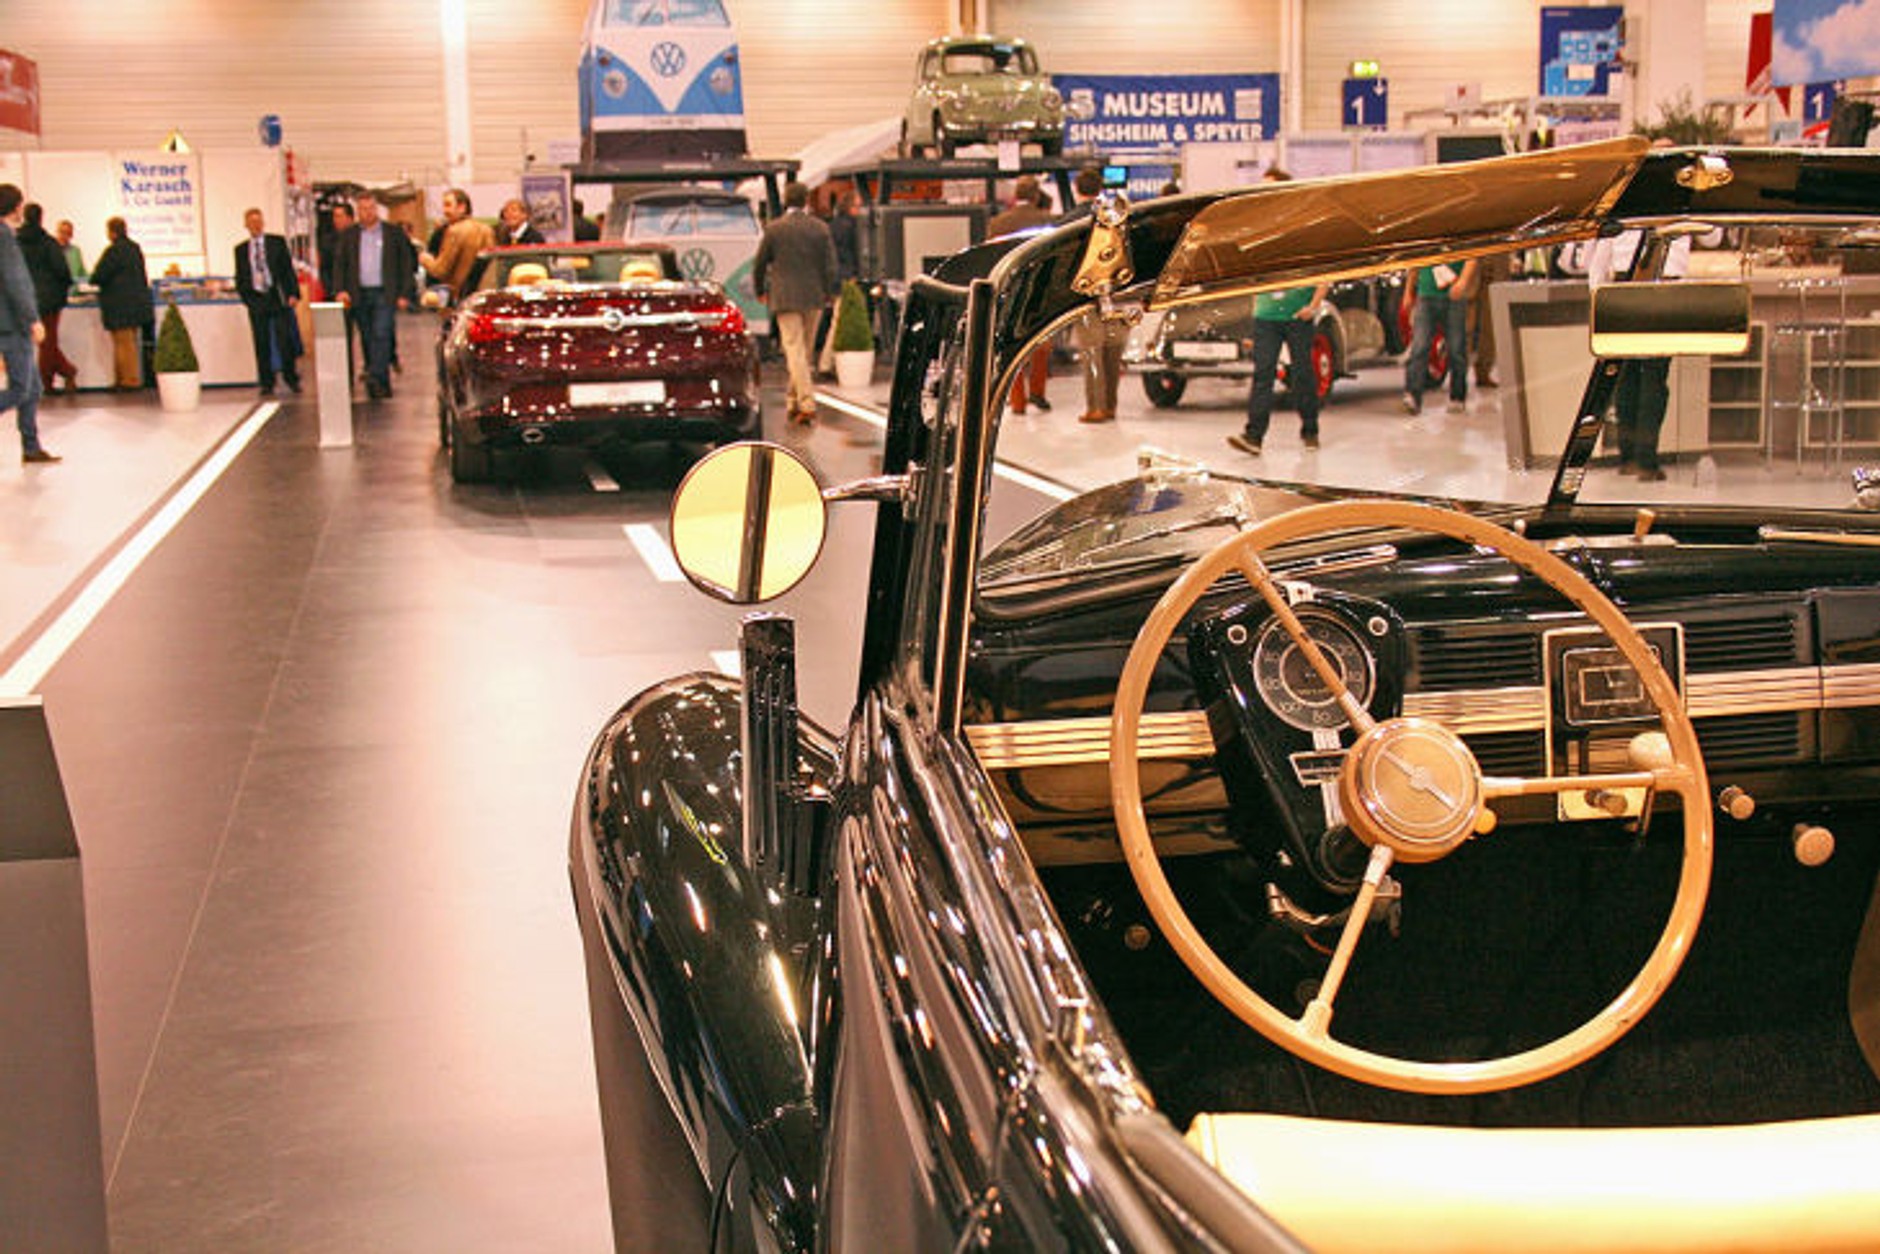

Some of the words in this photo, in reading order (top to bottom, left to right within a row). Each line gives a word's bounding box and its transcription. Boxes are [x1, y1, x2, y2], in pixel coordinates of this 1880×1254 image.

[1103, 92, 1226, 117] MUSEUM
[1351, 96, 1363, 125] 1
[1812, 91, 1824, 120] 1
[1069, 123, 1168, 142] SINSHEIM
[1173, 123, 1188, 141] &
[1194, 122, 1263, 141] SPEYER
[122, 161, 188, 176] Werner
